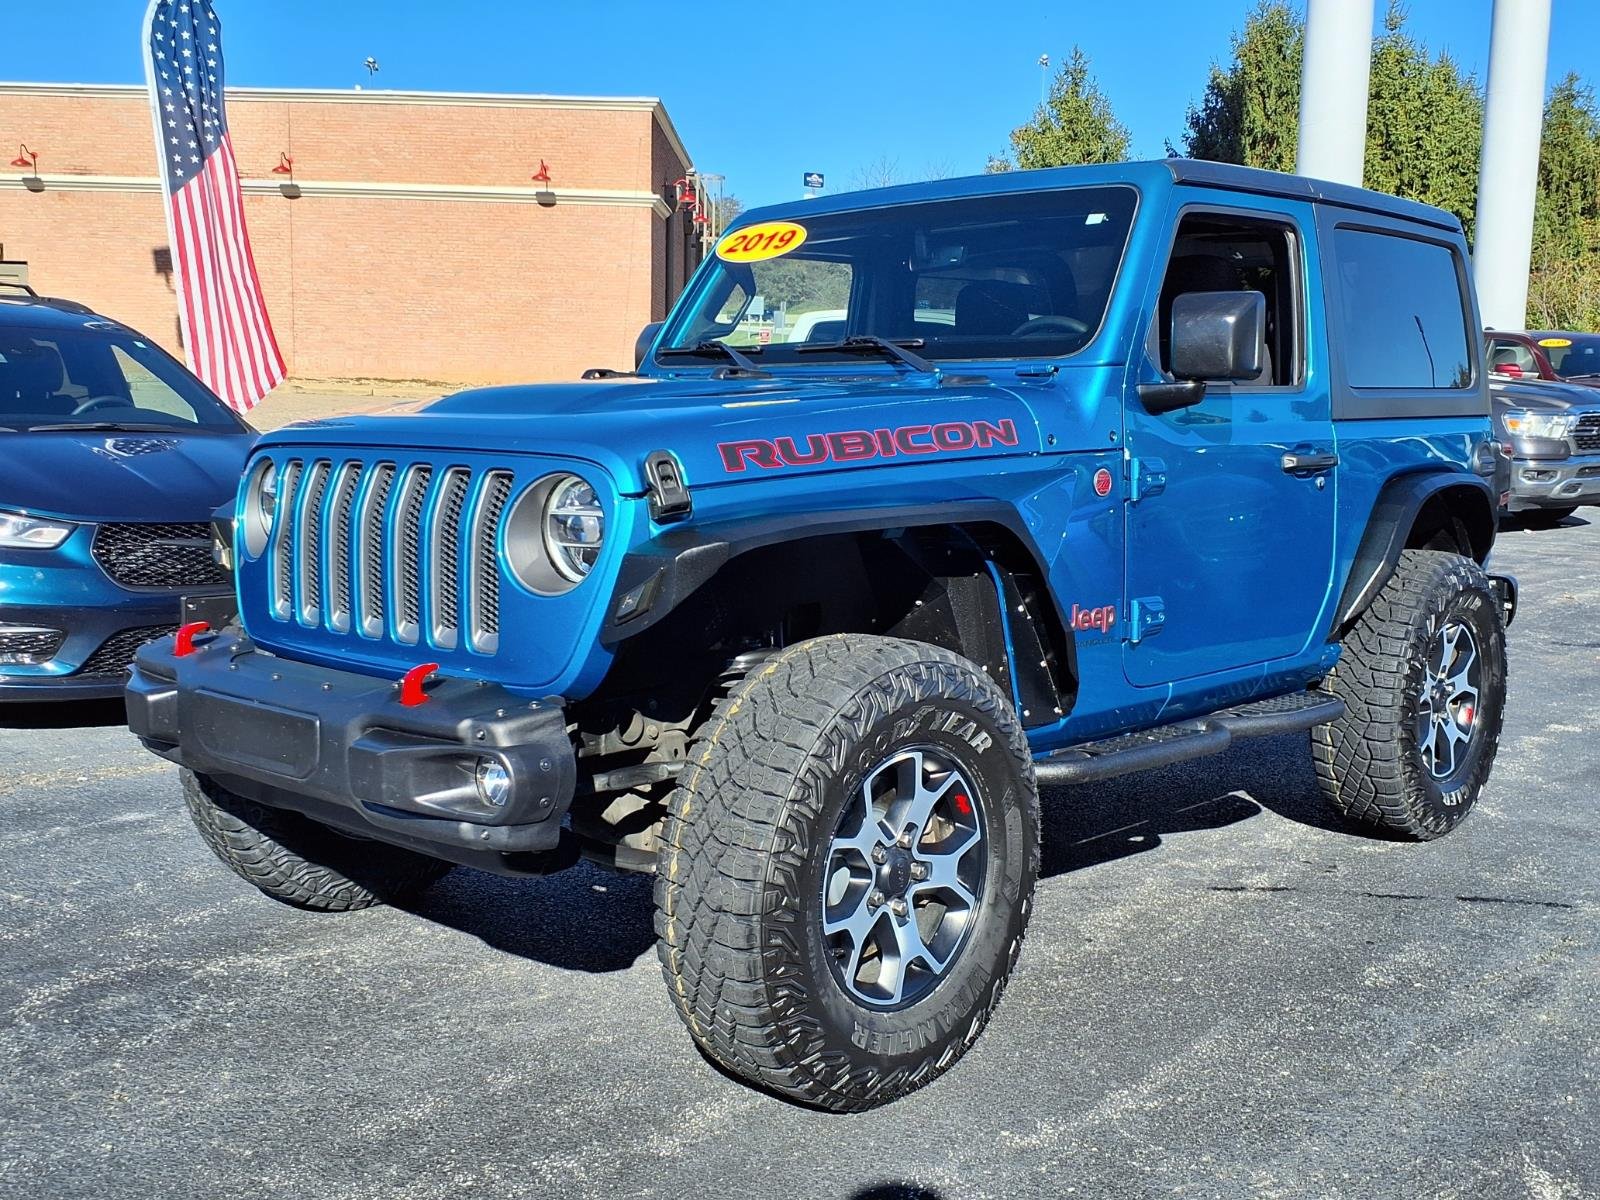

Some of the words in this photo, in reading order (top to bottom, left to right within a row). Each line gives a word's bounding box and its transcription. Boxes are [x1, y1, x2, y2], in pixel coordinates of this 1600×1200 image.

[724, 229, 797, 254] 2019
[717, 418, 1018, 472] RUBICON
[1070, 603, 1116, 633] Jeep
